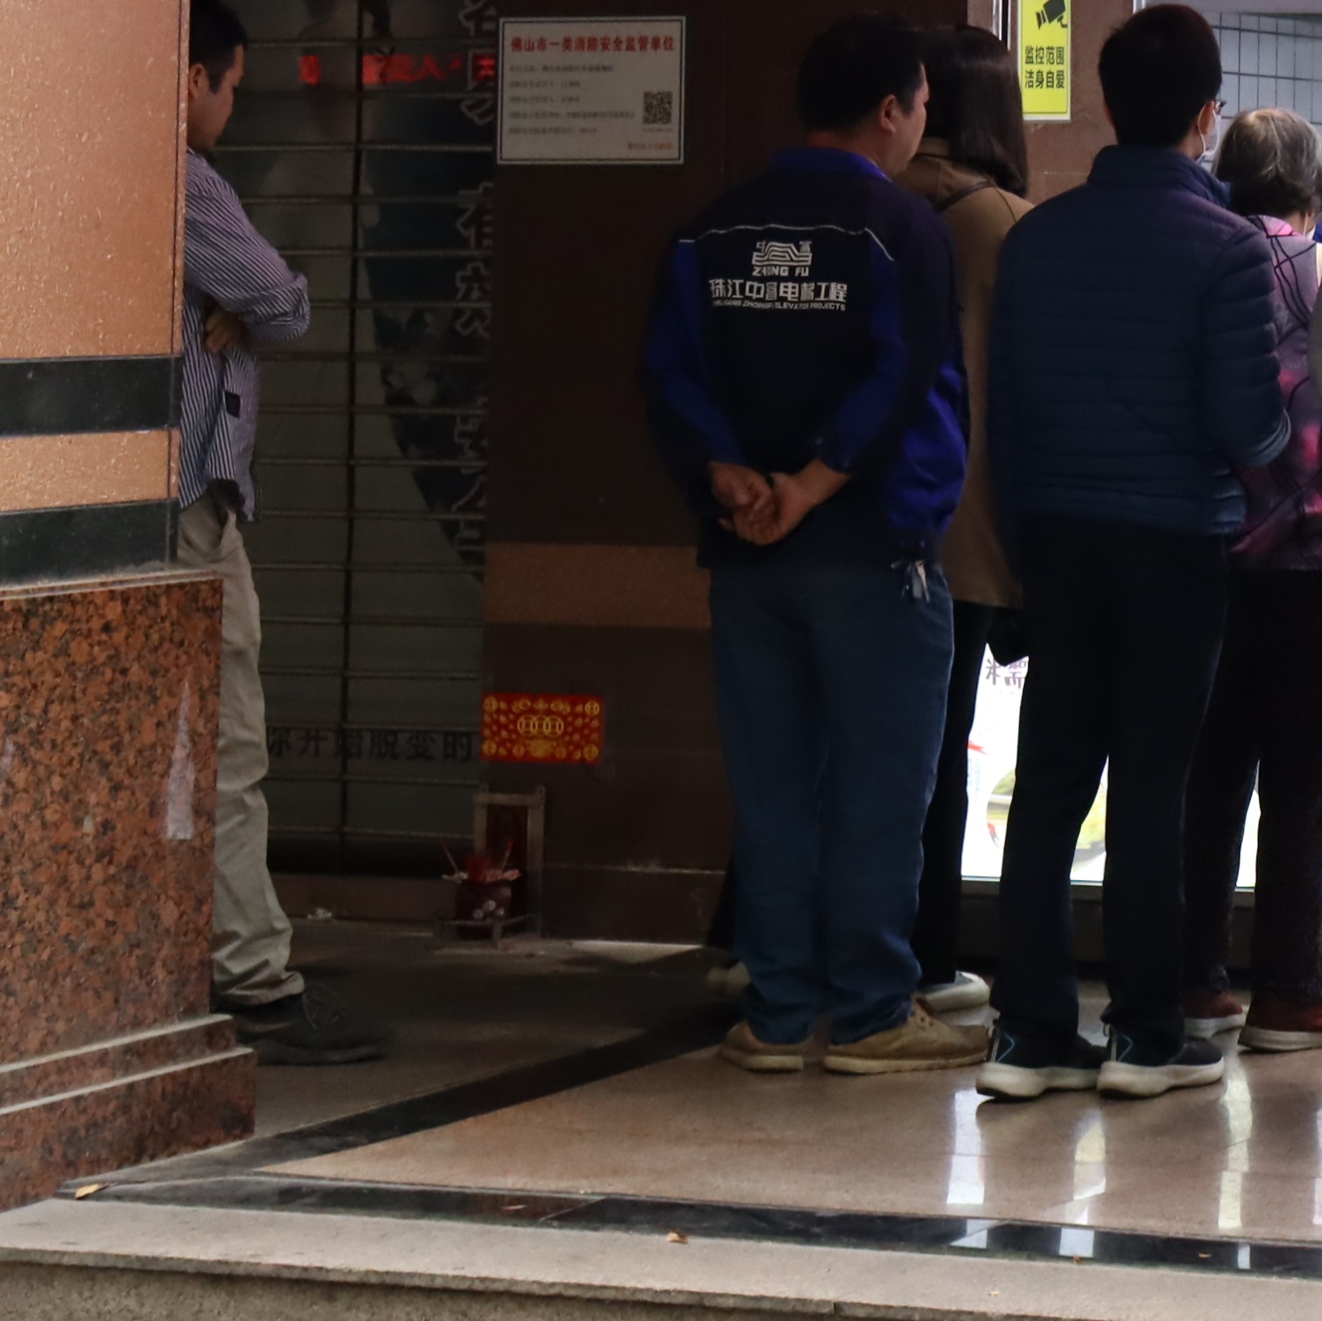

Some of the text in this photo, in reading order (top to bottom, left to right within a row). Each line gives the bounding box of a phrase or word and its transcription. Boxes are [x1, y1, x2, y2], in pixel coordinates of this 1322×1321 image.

[511, 35, 674, 53] 佛山市一类消防安全监管单位
[1024, 46, 1065, 66] 监控范围
[1024, 69, 1065, 89] 洁身自爱
[795, 266, 809, 277] FU
